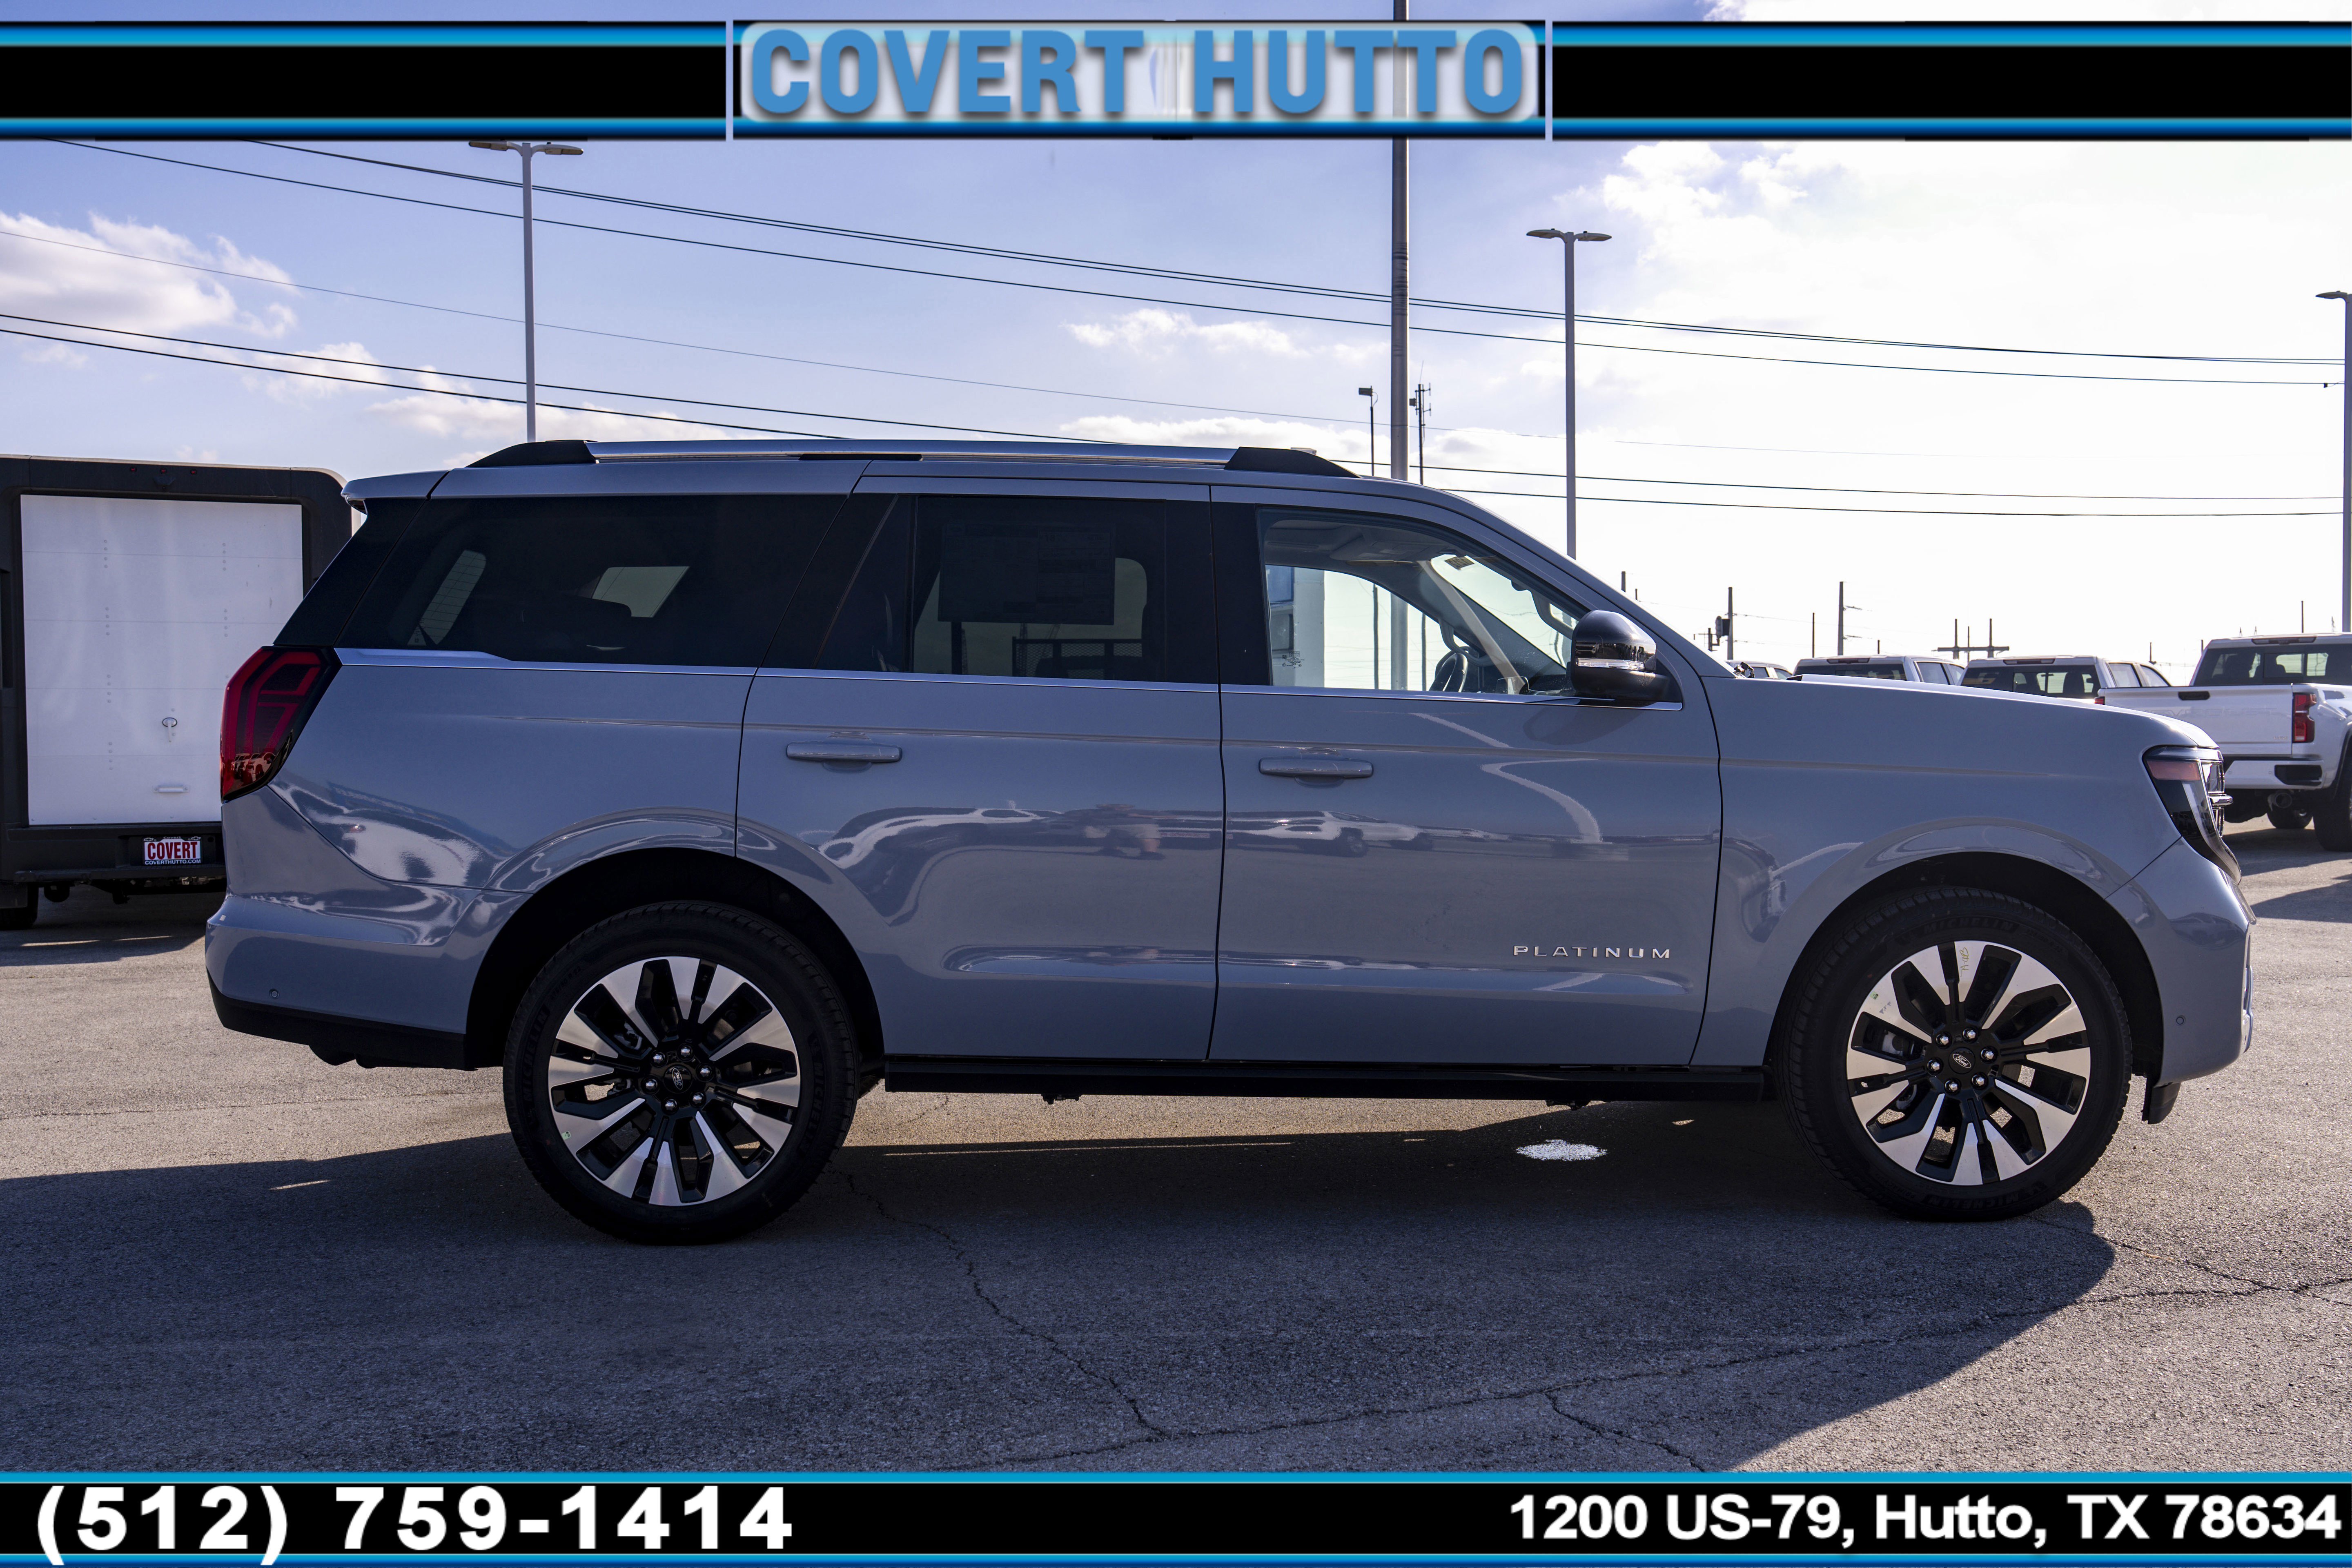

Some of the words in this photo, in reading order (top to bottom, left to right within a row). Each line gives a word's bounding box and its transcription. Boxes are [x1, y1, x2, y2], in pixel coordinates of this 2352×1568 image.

[147, 842, 198, 860] COVERT
[1923, 918, 2014, 935] MICHELIN
[1513, 946, 1670, 959] PLATINUM
[523, 1010, 548, 1102] MICHELIN
[1955, 1056, 1969, 1067] Ford
